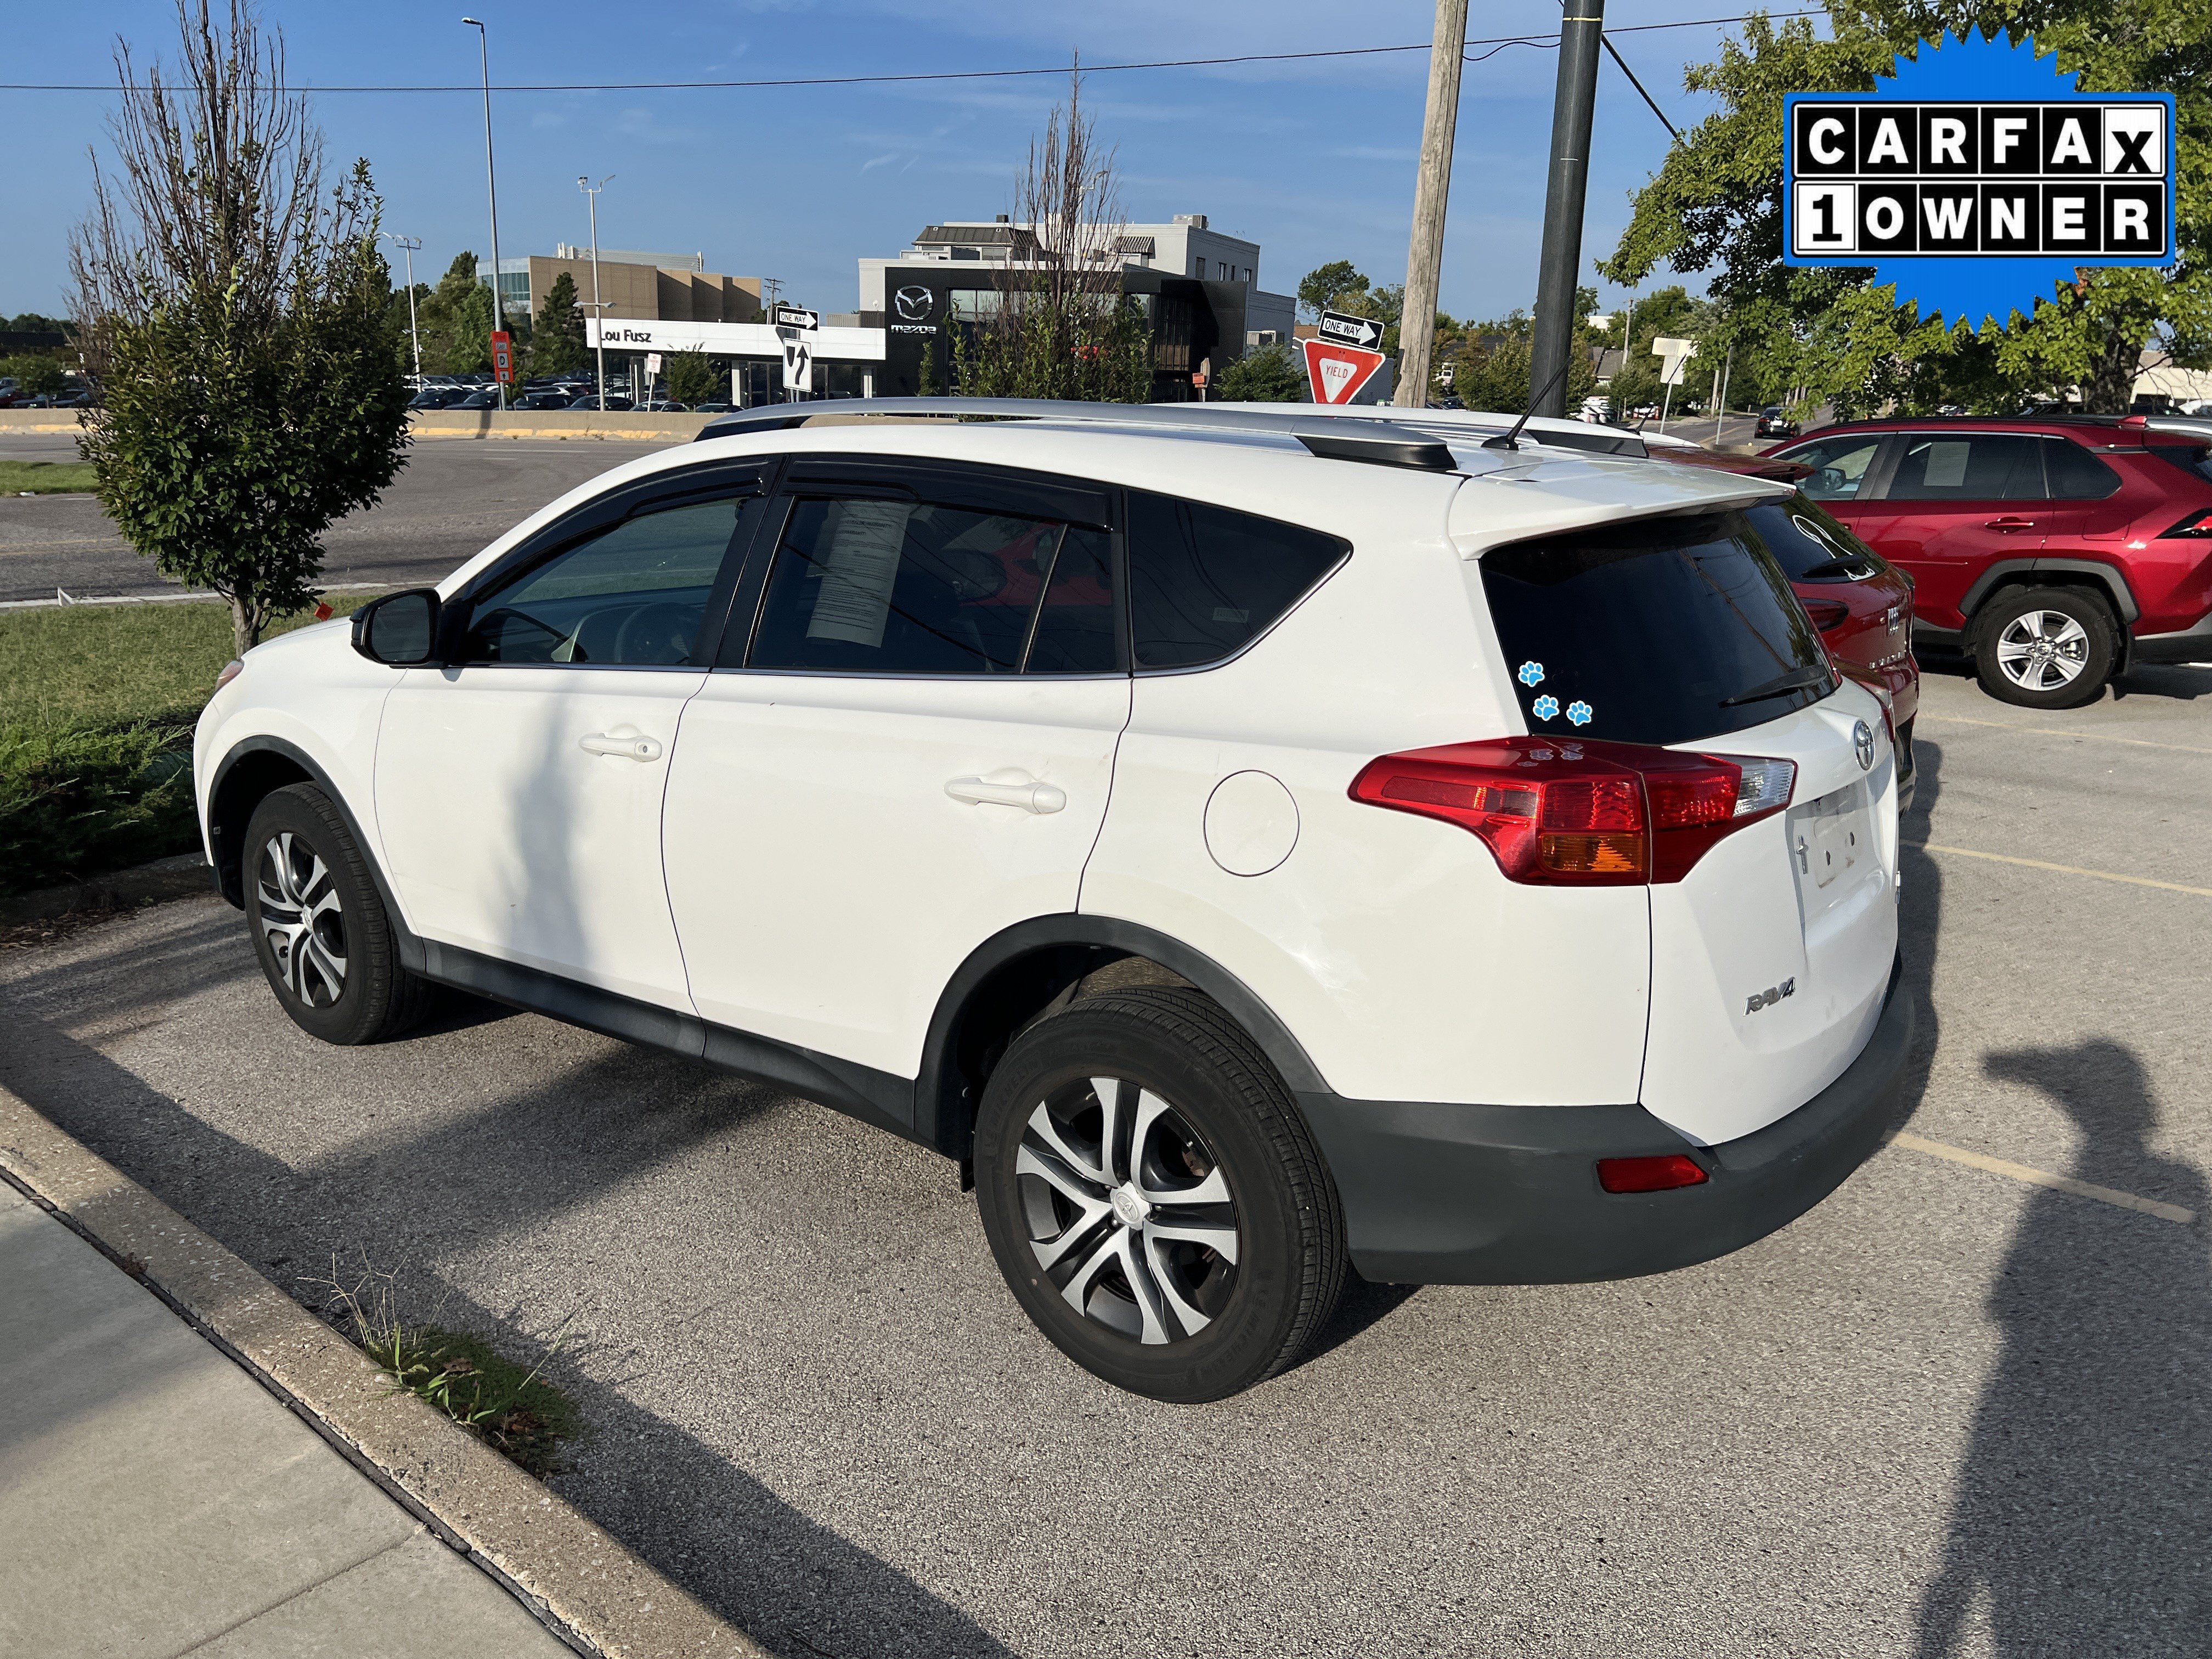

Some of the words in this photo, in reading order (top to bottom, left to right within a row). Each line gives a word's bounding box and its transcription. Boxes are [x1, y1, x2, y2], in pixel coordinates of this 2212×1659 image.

[781, 313, 793, 322] ONE
[794, 315, 806, 324] WAY
[1325, 320, 1341, 332] ONE
[1344, 324, 1361, 336] WAY
[623, 329, 652, 343] Fusz
[500, 356, 505, 365] D
[1326, 365, 1348, 379] YIELD
[1742, 976, 1796, 1017] RAV4
